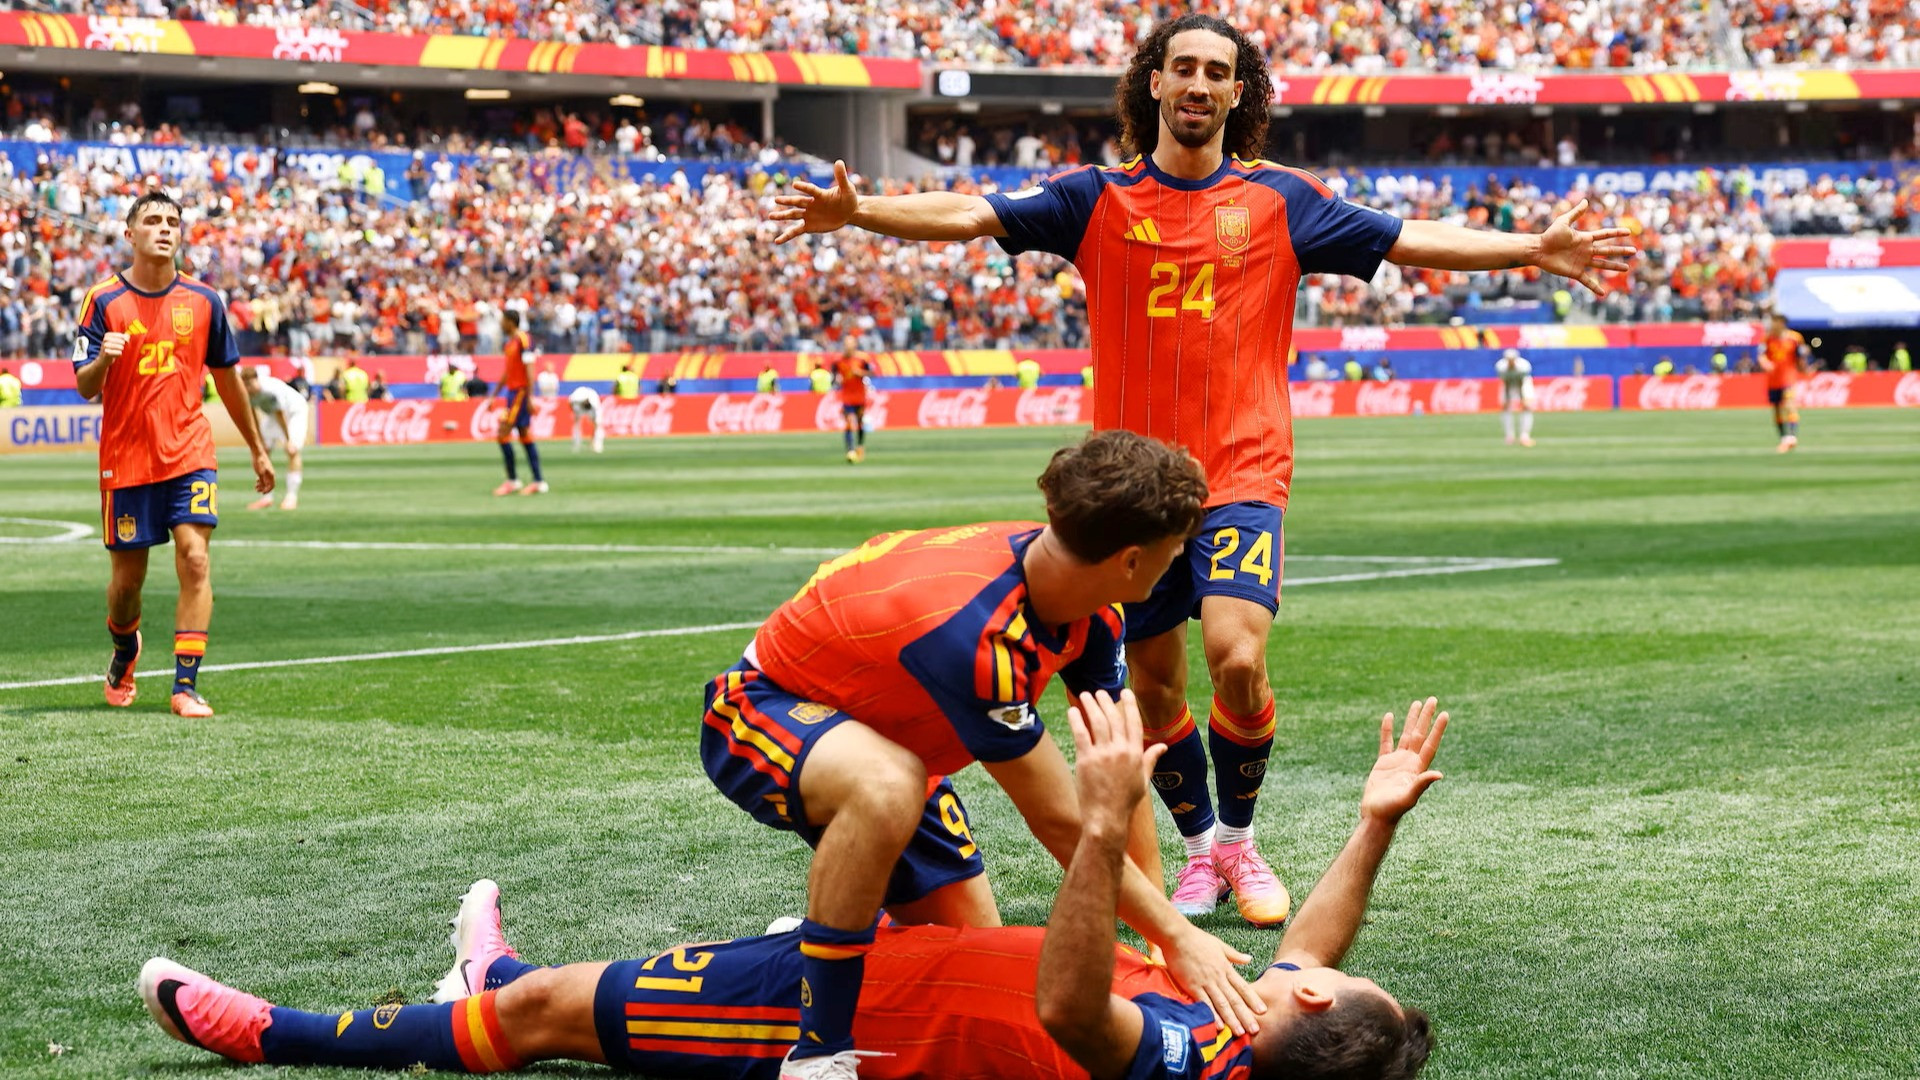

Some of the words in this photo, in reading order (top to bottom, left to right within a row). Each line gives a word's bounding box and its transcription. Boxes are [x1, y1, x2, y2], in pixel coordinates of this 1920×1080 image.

[1147, 262, 1216, 319] 24
[138, 340, 175, 375] 20
[1209, 527, 1273, 586] 24
[938, 793, 976, 860] 9
[635, 949, 714, 993] 21
